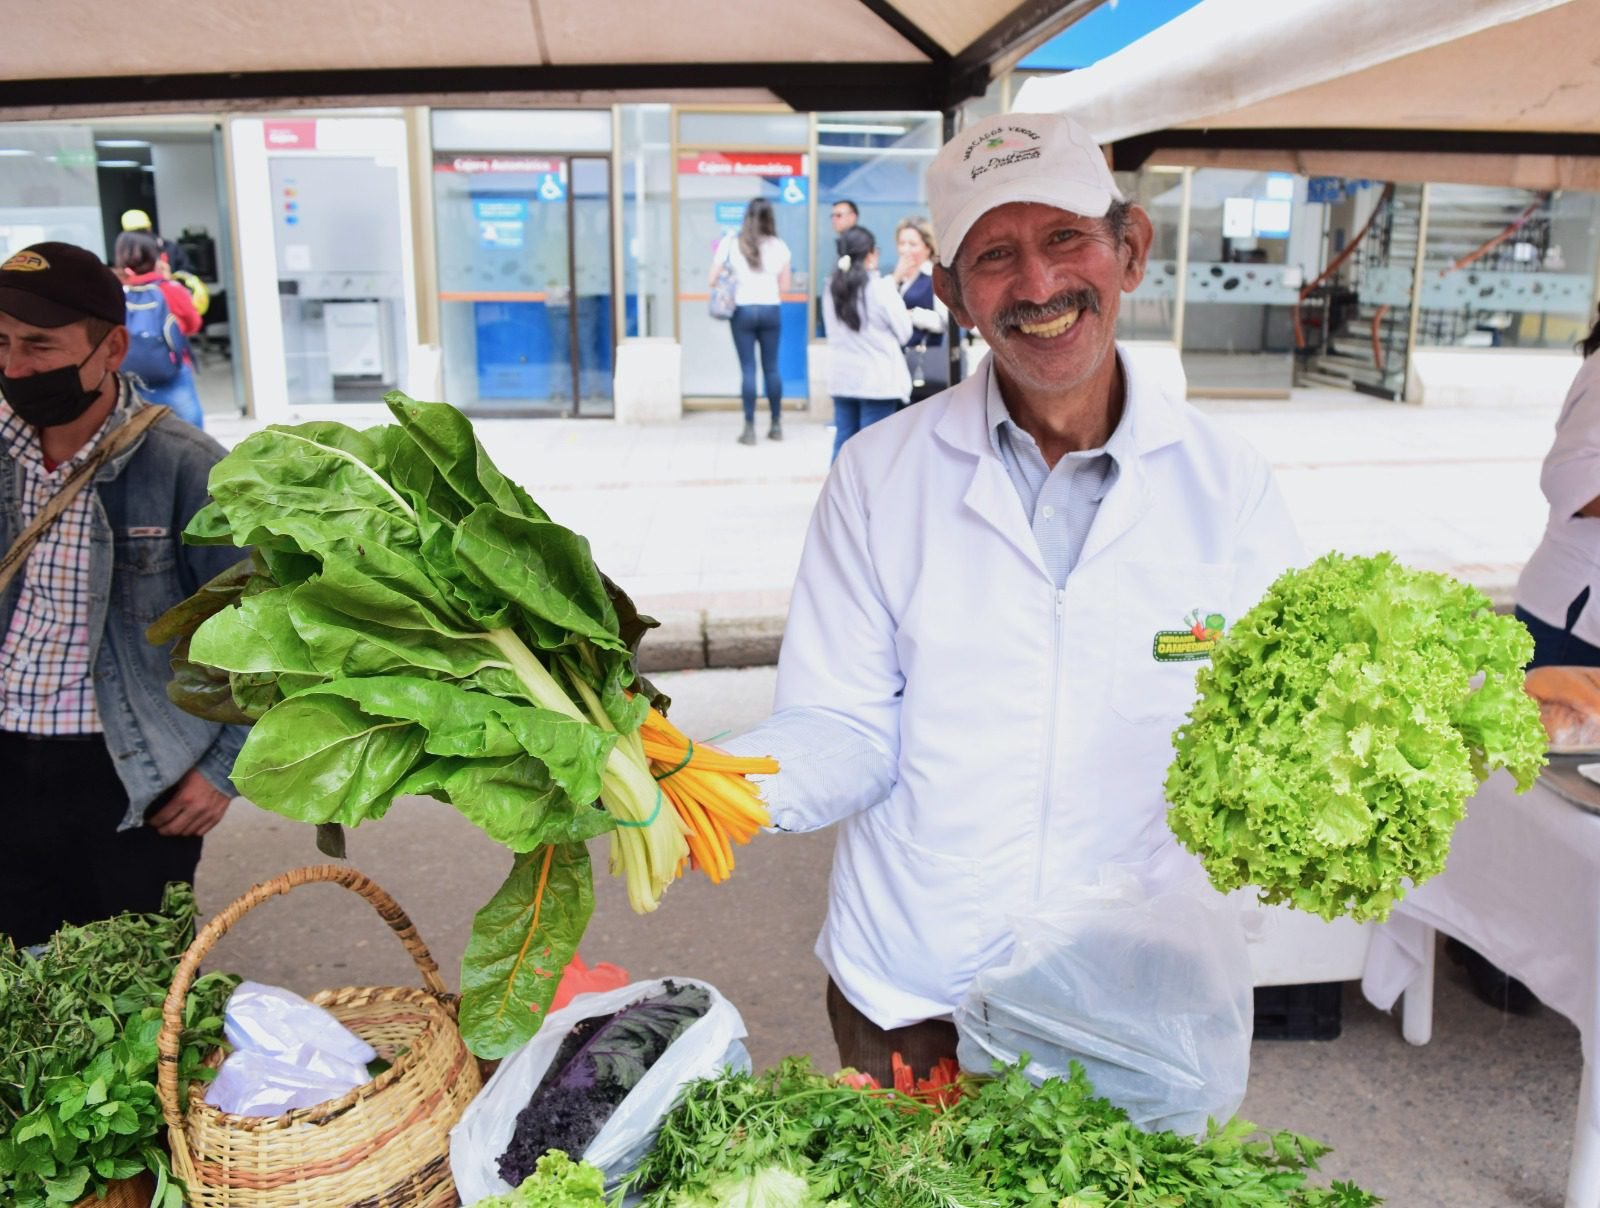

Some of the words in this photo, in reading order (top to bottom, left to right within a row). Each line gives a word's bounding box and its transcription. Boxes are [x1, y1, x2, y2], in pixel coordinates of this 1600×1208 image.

[963, 128, 1002, 161] MERCADOS
[1008, 126, 1040, 140] VERDES
[698, 162, 732, 175] Cajero
